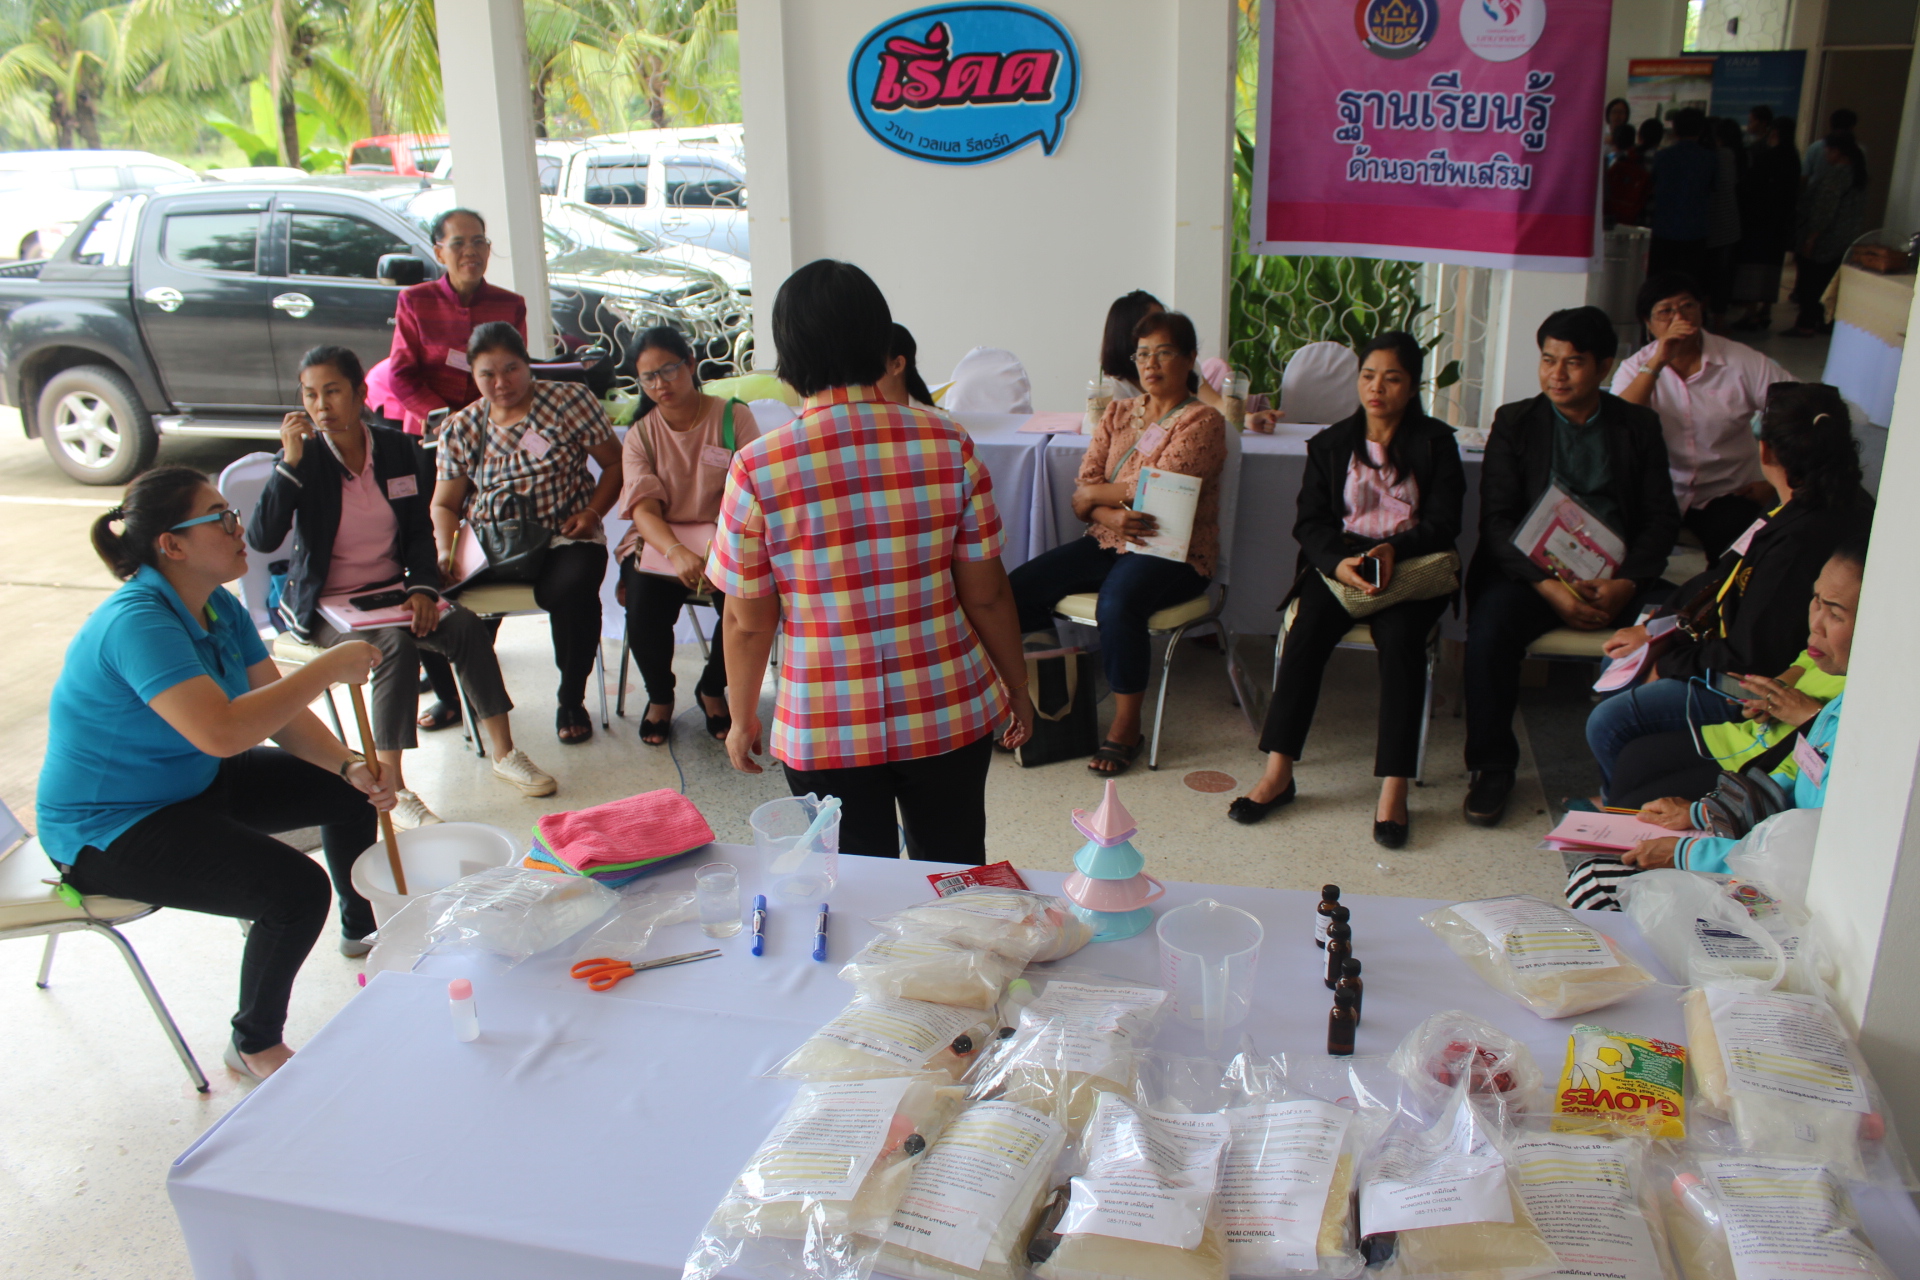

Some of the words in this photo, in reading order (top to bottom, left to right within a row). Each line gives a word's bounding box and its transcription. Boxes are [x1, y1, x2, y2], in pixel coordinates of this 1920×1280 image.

[1335, 71, 1554, 150] ฐานเรียนรู้
[885, 120, 914, 143] วานา
[918, 136, 961, 152] เวลเนส
[966, 133, 1010, 152] รีสอร์ท
[1347, 146, 1531, 190] ด้านอาชีพเสริม
[1561, 1088, 1680, 1117] GLOVES
[1096, 1207, 1126, 1216] NONGKHAI
[1127, 1210, 1155, 1220] CHEMICAL
[1400, 1200, 1430, 1210] NONGKHAI
[1432, 1196, 1462, 1205] CHEMICAL
[893, 1221, 904, 1229] 085
[905, 1223, 916, 1232] 811
[916, 1227, 931, 1236] 7048
